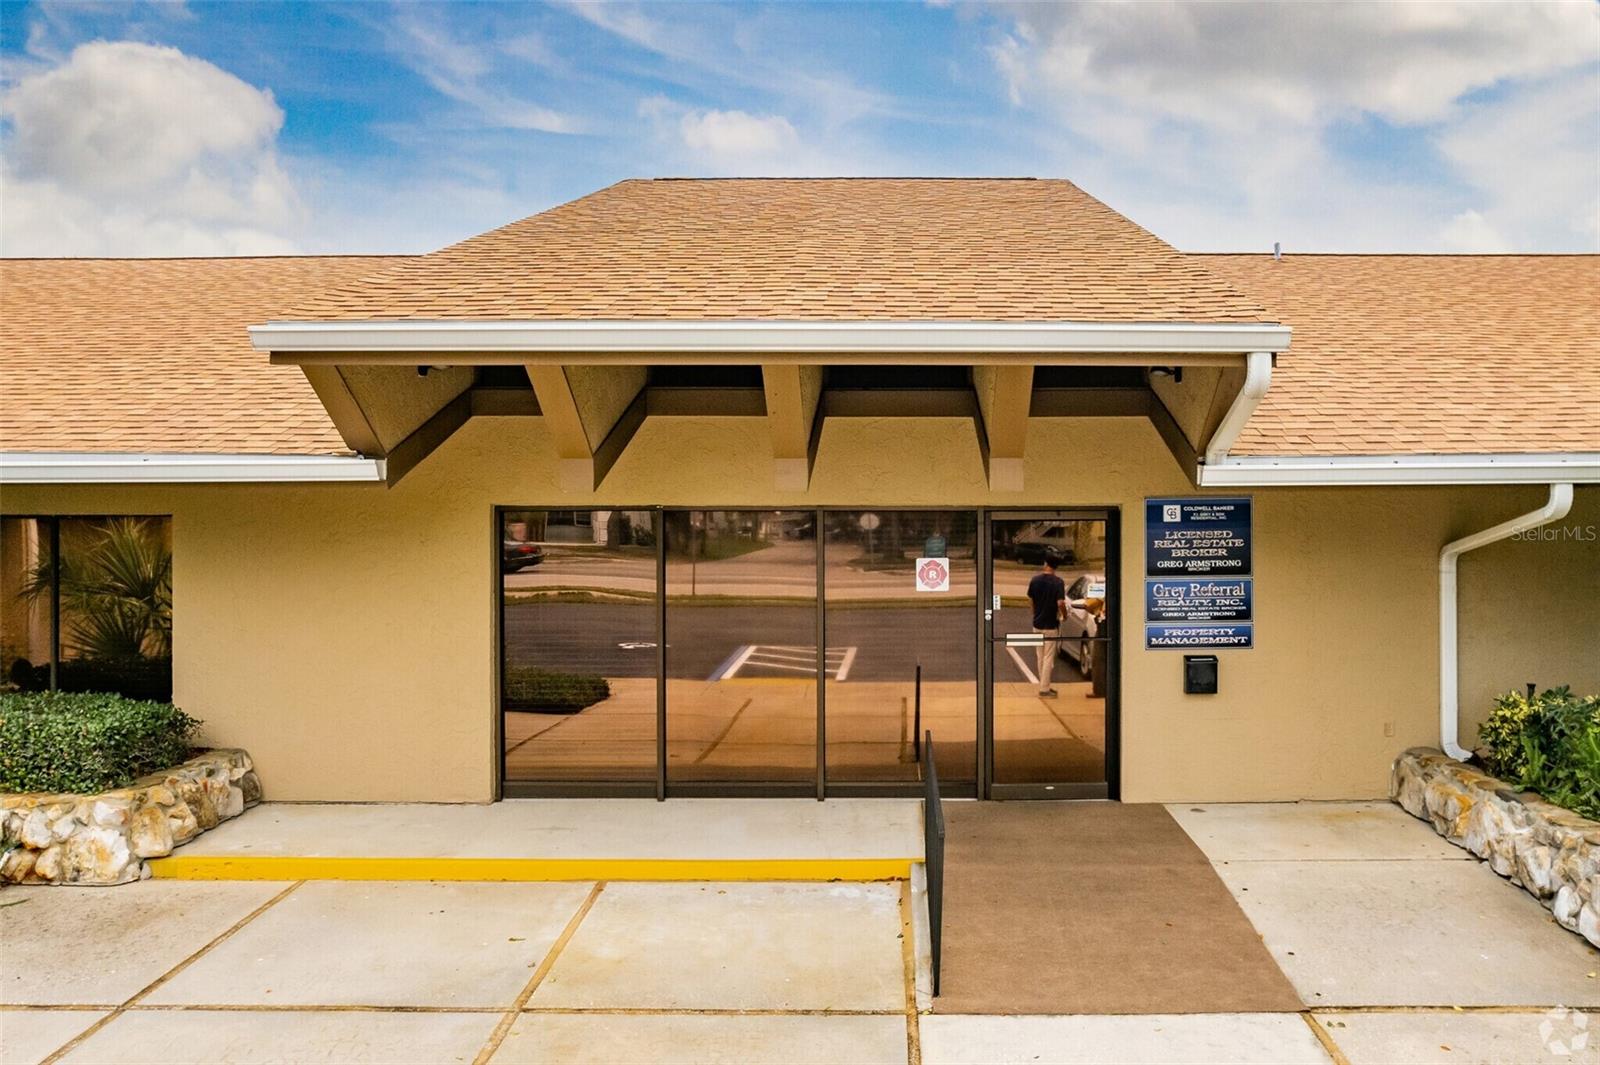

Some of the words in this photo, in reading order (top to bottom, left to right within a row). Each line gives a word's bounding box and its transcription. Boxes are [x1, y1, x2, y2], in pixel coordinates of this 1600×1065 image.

[1165, 530, 1233, 539] LICENSED
[1154, 540, 1190, 548] REAL
[1193, 539, 1245, 547] ESTATE
[1171, 548, 1228, 557] BROKER
[1153, 583, 1187, 600] Grey
[1190, 582, 1245, 597] Referral
